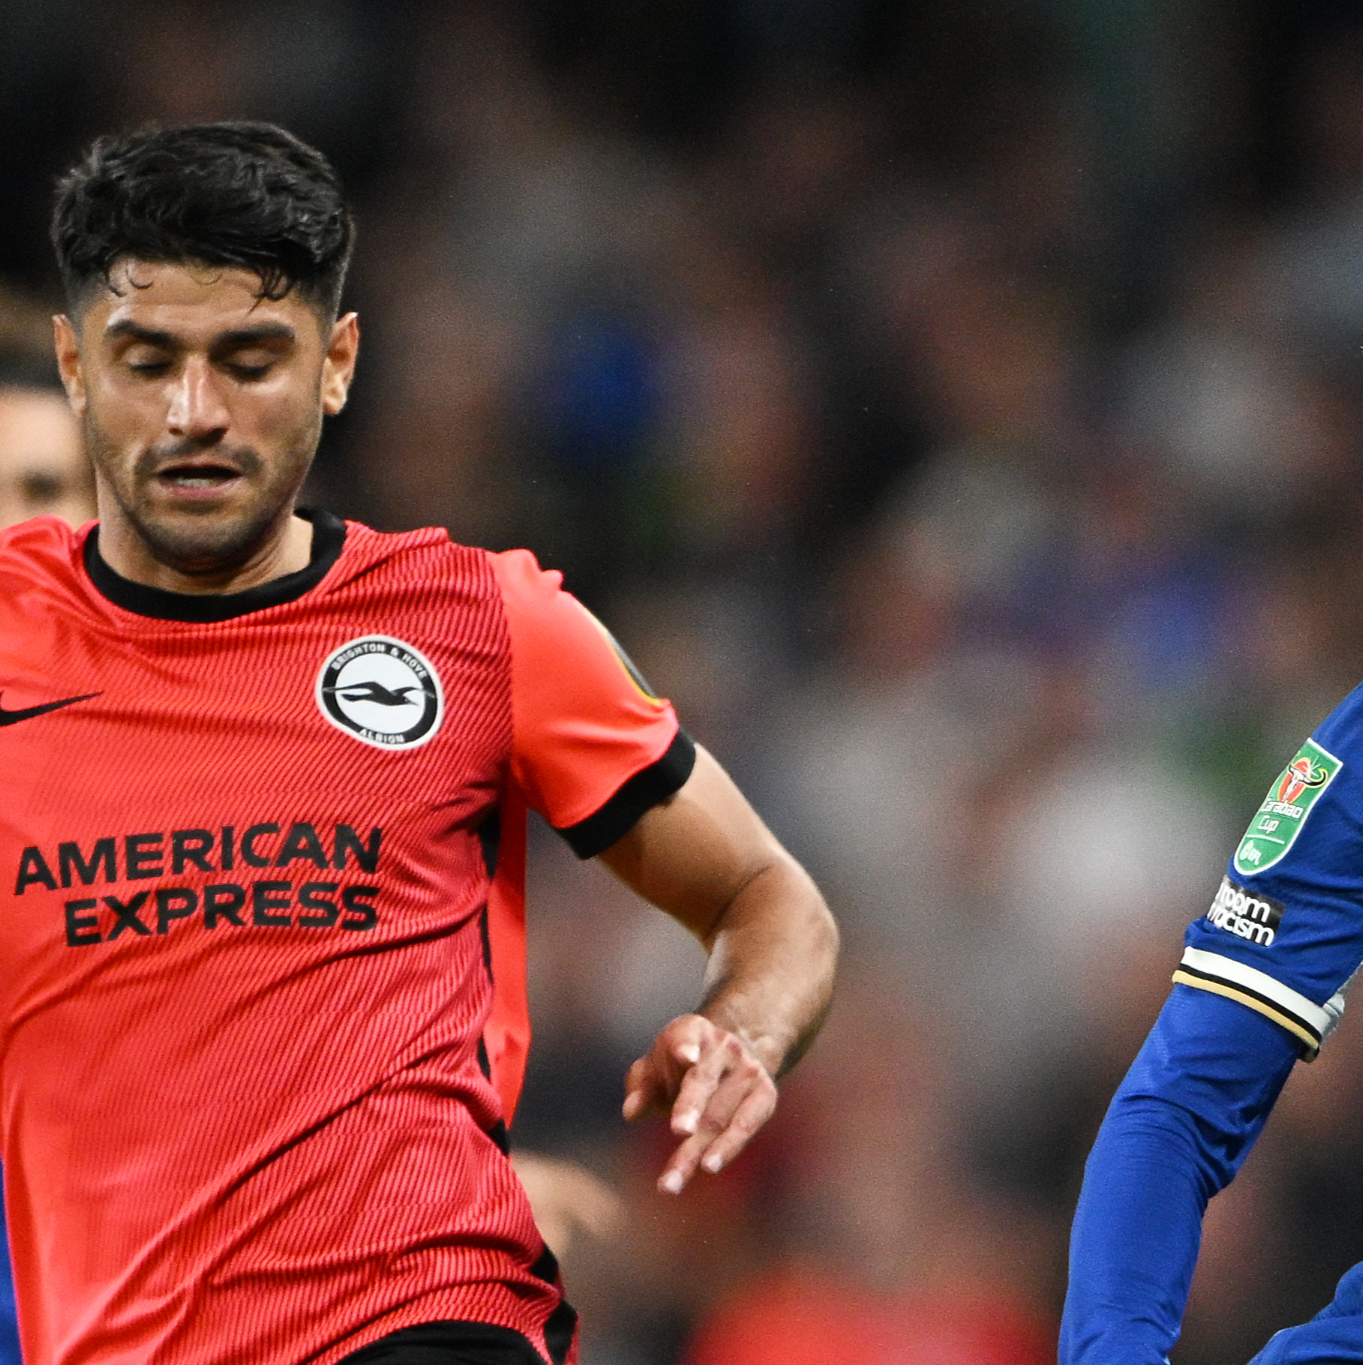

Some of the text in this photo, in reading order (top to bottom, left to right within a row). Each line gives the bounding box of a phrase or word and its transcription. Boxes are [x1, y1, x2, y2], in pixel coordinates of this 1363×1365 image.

[331, 643, 428, 679] BRIGHTON & HOVE
[359, 728, 405, 745] ALBION
[1257, 815, 1280, 834] Cup
[14, 822, 383, 896] AMERICAN
[64, 880, 381, 948] EXPRESS
